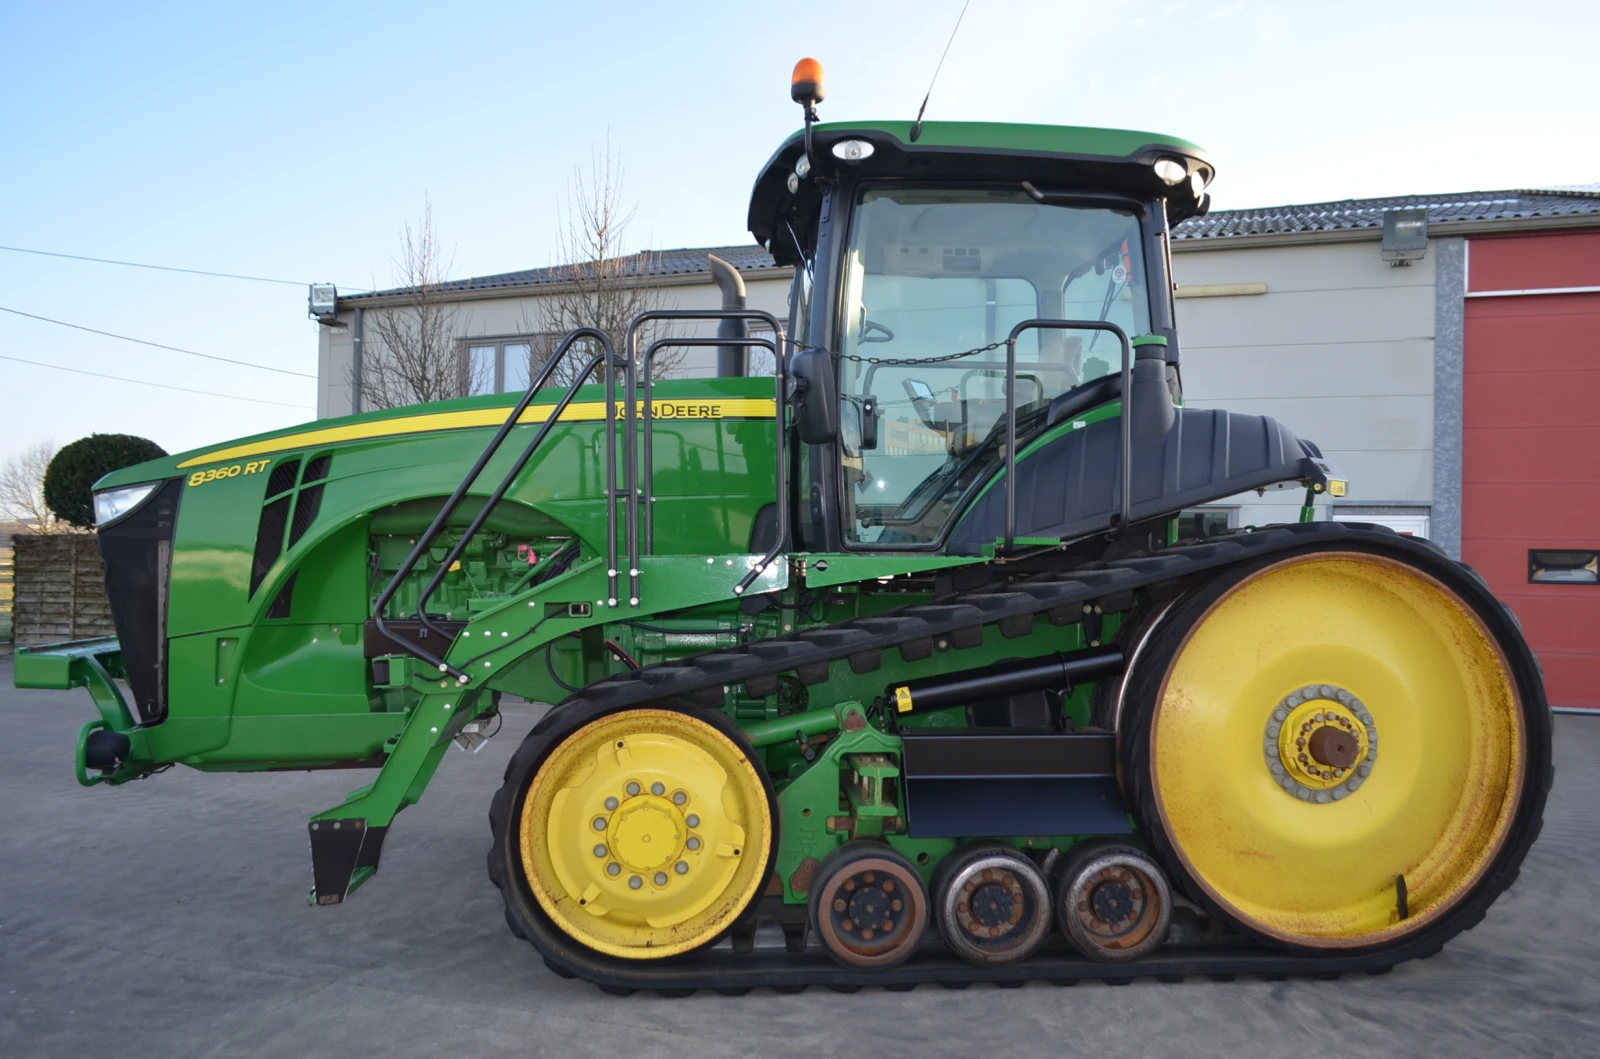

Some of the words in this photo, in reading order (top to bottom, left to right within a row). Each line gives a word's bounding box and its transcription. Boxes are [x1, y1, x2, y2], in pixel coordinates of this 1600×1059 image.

[661, 403, 721, 417] DEERE
[188, 465, 242, 487] 8360
[243, 459, 271, 475] RT
